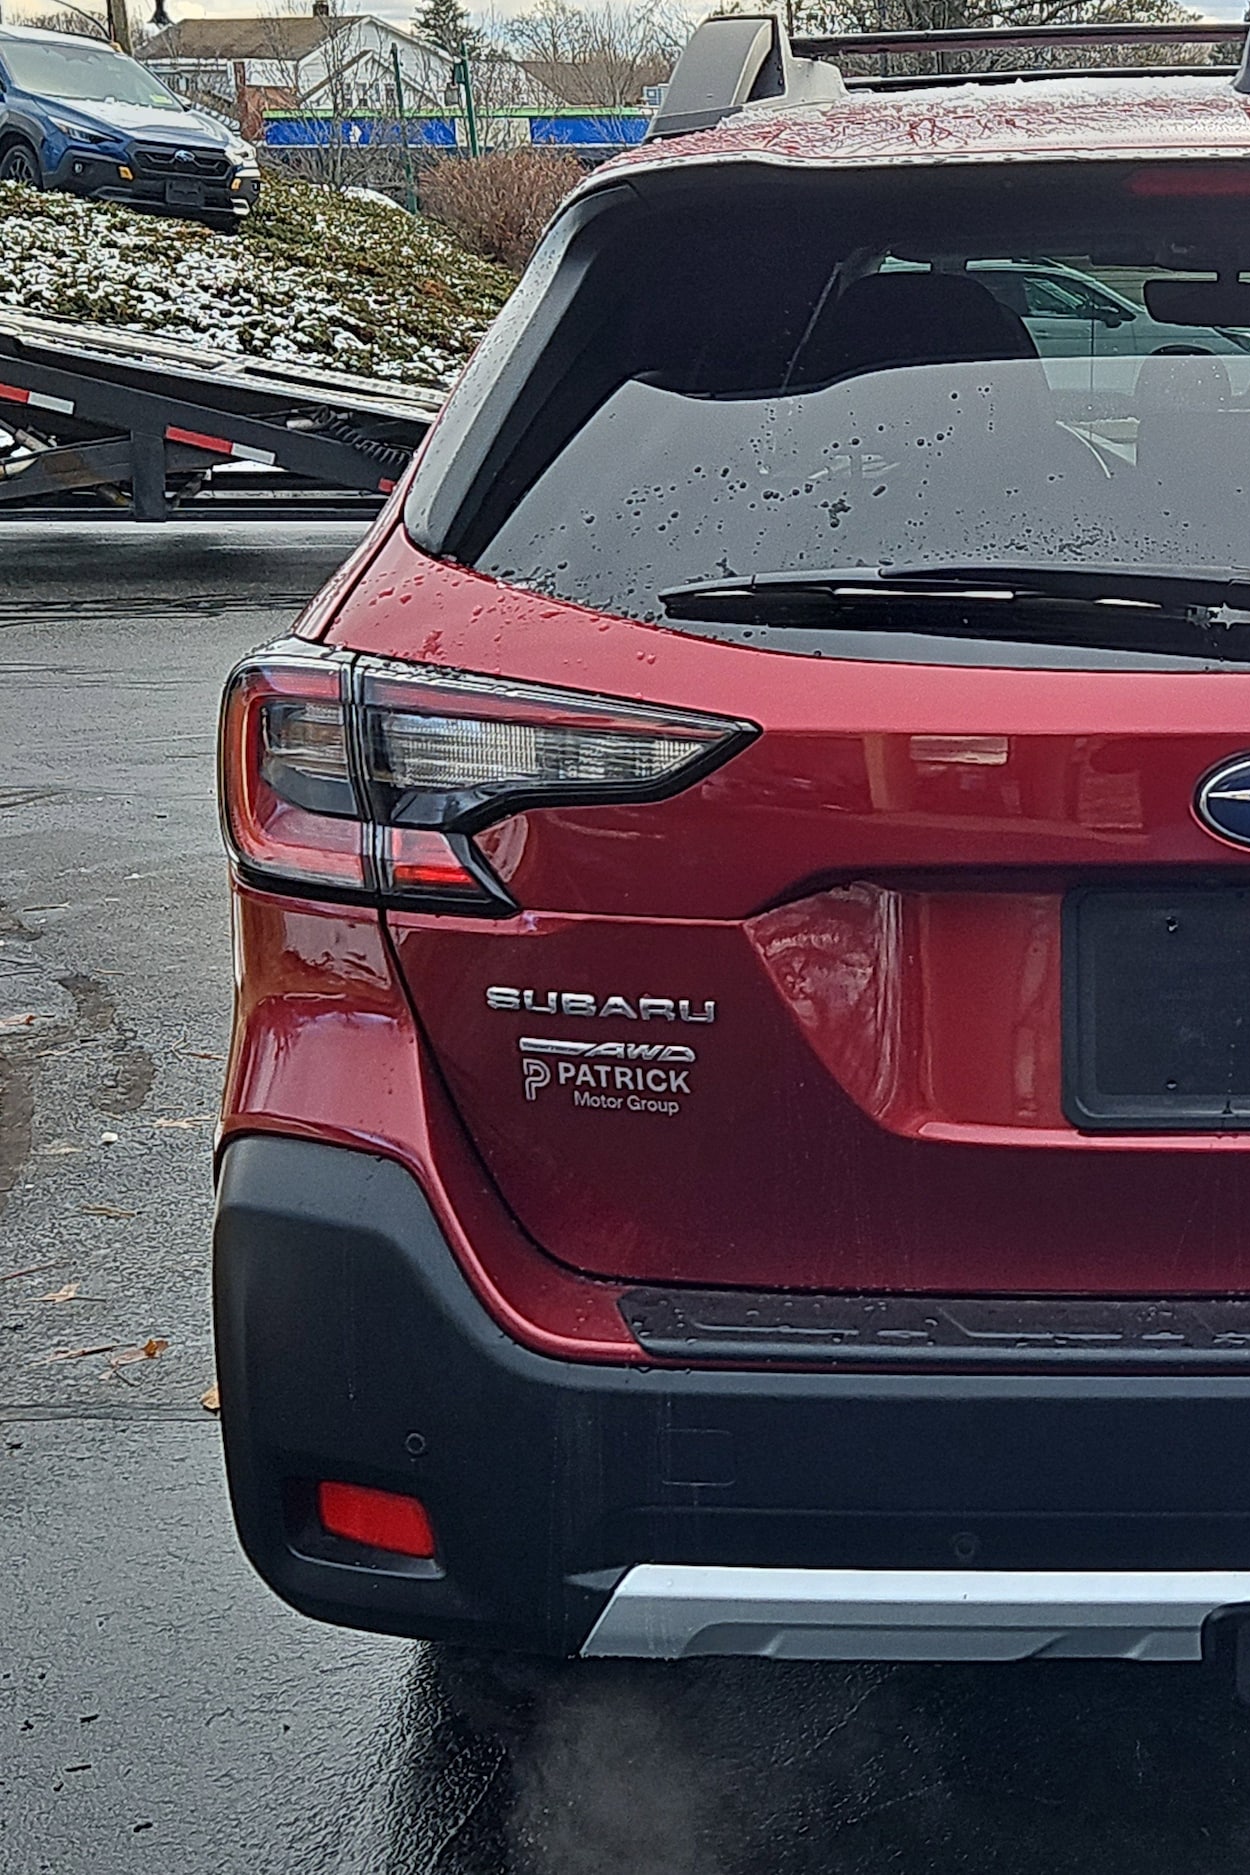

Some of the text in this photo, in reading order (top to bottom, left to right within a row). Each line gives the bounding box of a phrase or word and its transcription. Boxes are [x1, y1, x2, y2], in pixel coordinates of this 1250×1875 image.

[486, 986, 716, 1023] SUBARU
[558, 1061, 692, 1094] PATRICK
[574, 1090, 680, 1117] Motor Group
